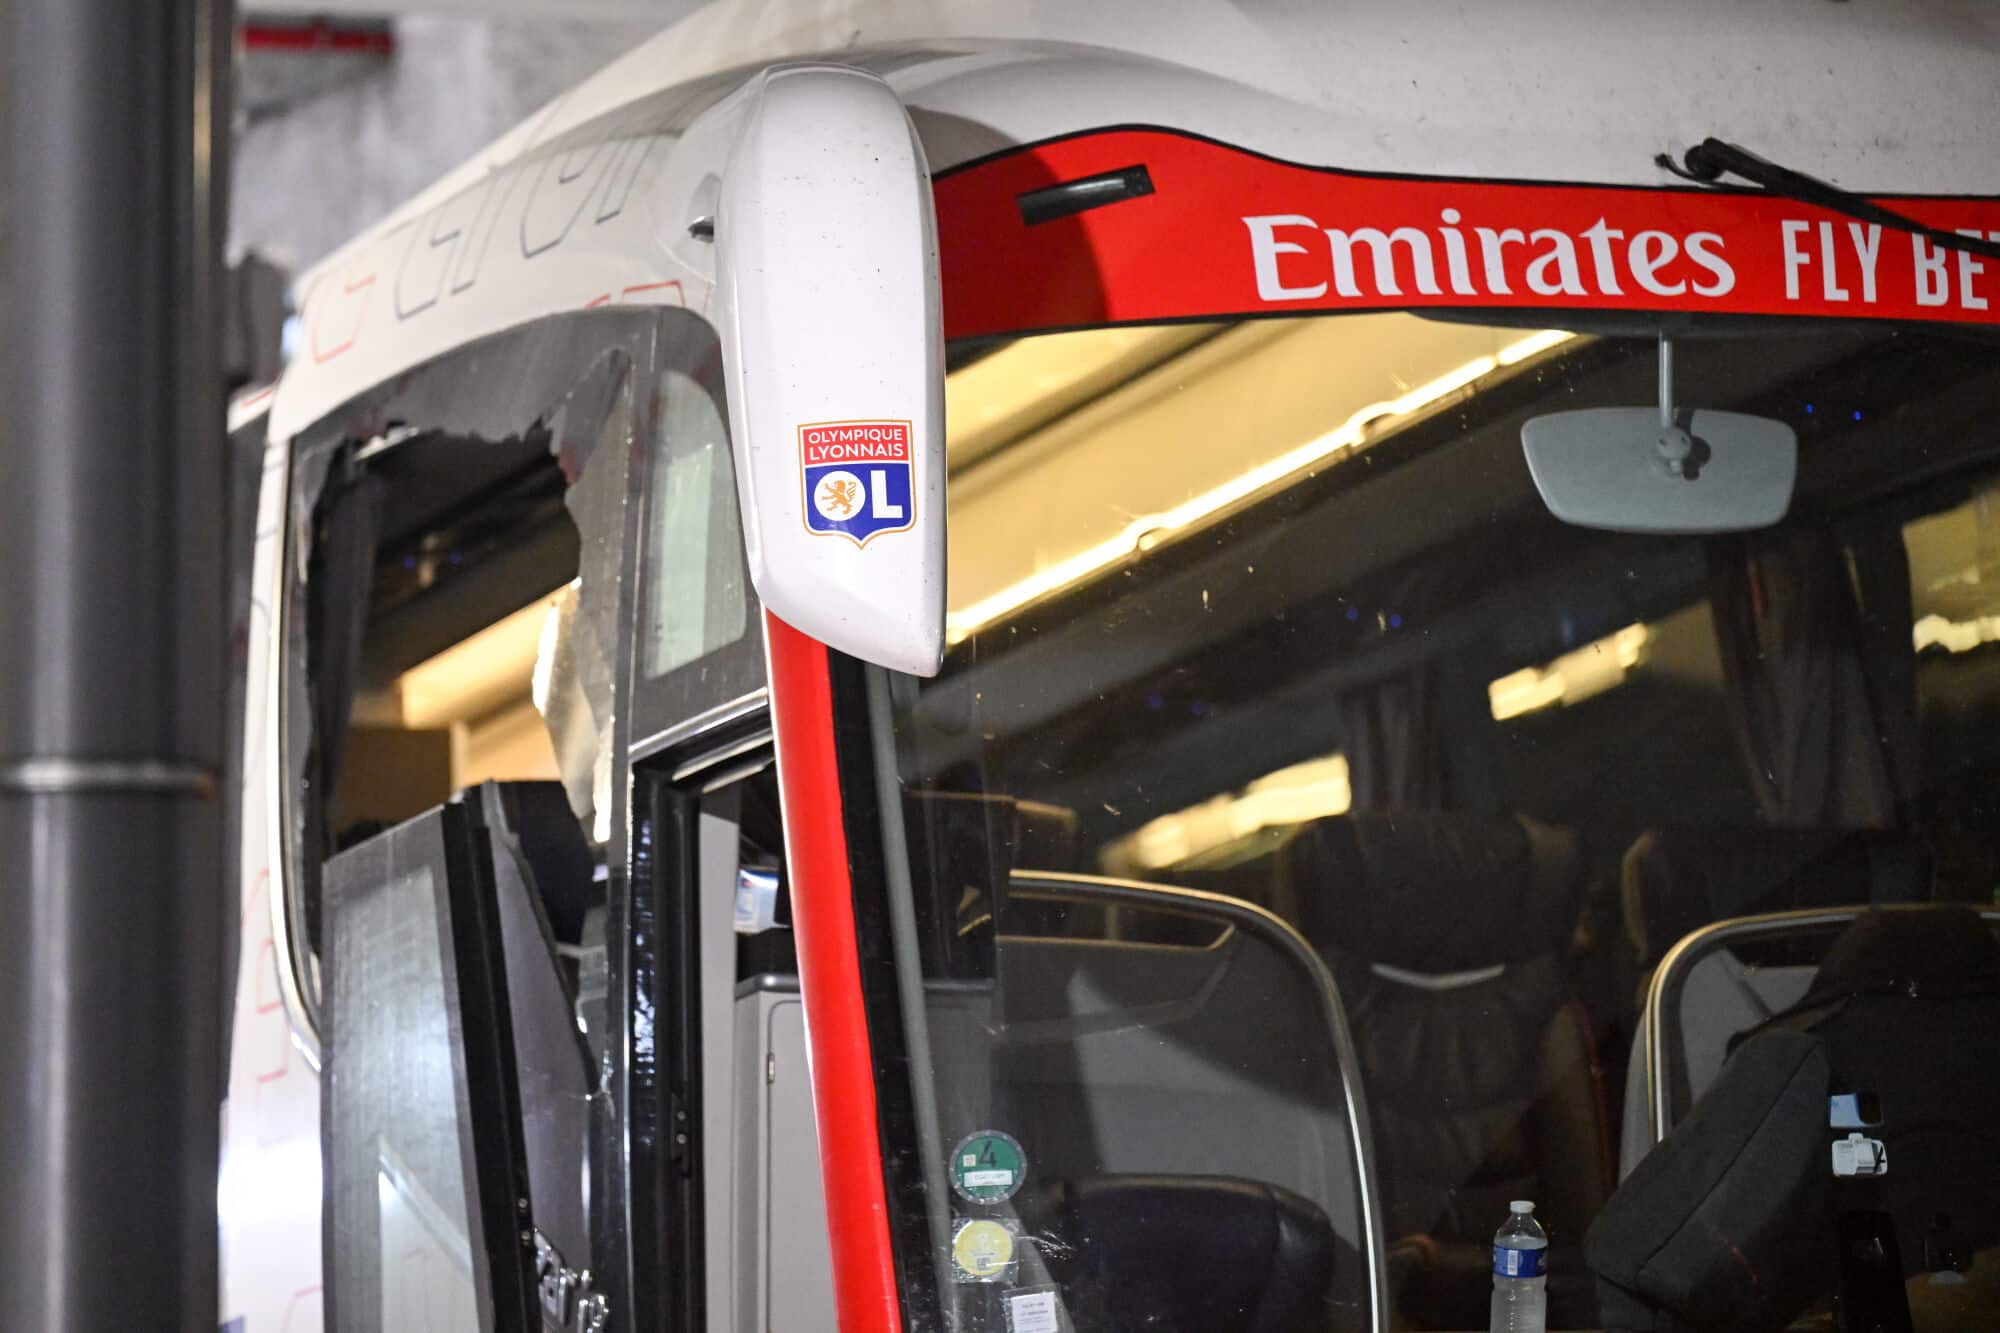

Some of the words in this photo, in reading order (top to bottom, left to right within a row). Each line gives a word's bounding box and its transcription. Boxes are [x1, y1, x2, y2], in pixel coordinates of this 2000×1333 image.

[1241, 208, 1736, 302] Emirates
[1781, 219, 1882, 303] FLY
[1911, 218, 2000, 310] BE
[808, 428, 903, 444] OLYMPIQUE
[809, 443, 904, 461] LYONNAIS
[813, 469, 904, 522] OL
[978, 1140, 996, 1168] 4
